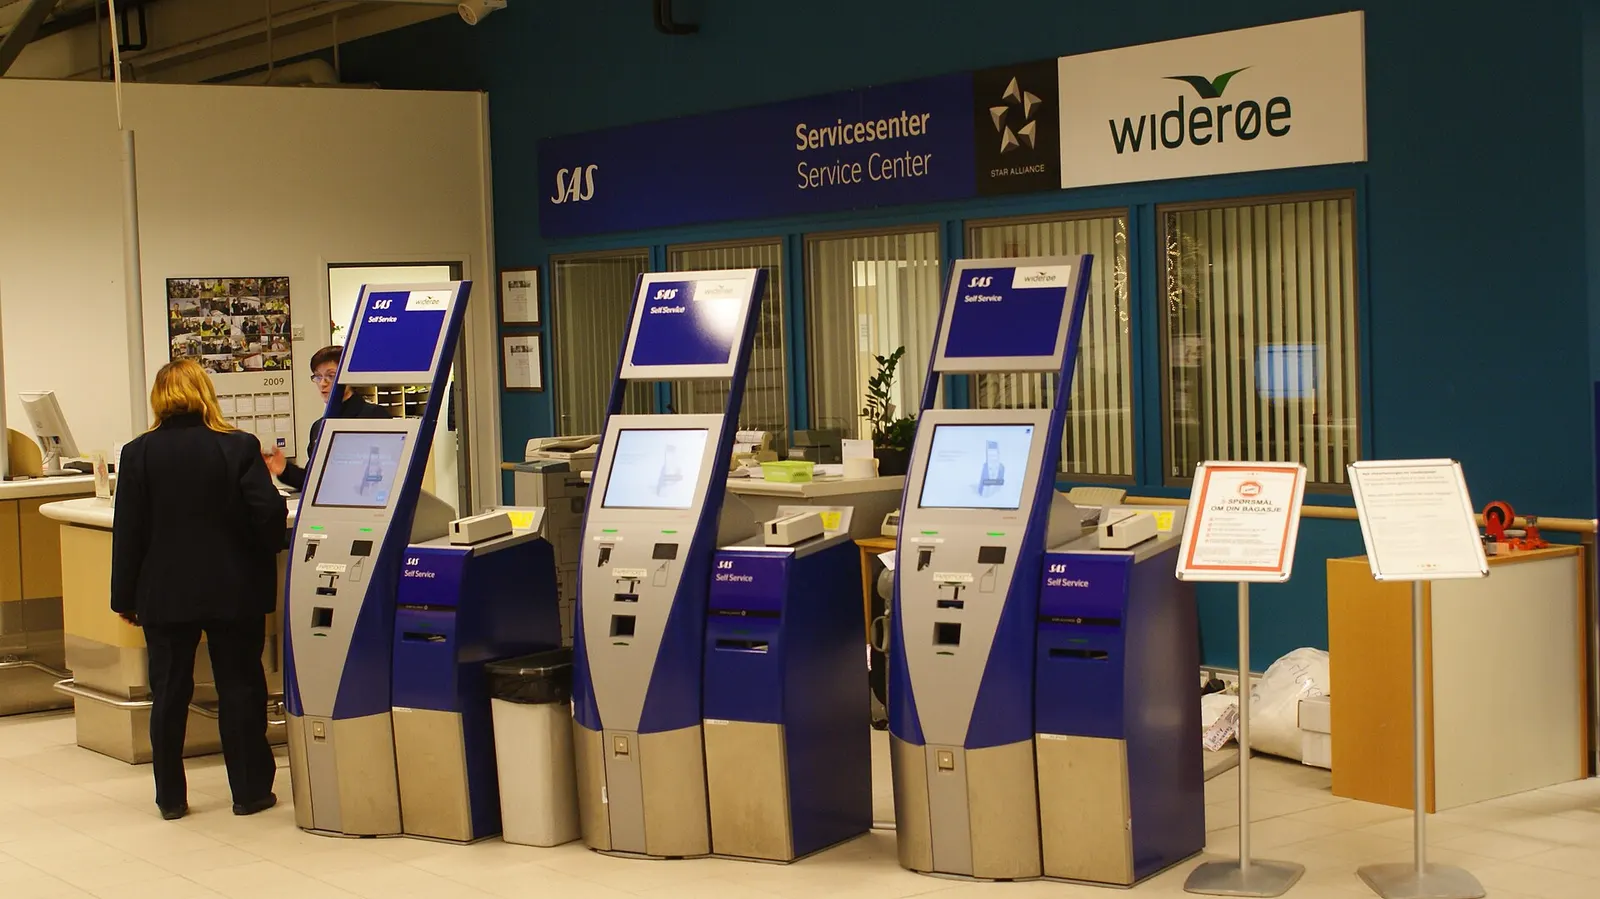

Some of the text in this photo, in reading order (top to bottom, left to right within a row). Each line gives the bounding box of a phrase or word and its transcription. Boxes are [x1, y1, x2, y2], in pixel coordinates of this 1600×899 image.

[1108, 95, 1292, 155] widerøe
[795, 109, 930, 151] Servicesenter
[797, 150, 932, 189] Service Center
[990, 164, 1045, 178] STAR ALLIANCE
[551, 164, 598, 205] SAS
[968, 276, 993, 288] SAS
[654, 288, 678, 300] SAS
[964, 294, 1003, 303] Self Service
[372, 300, 392, 309] SAS
[662, 306, 685, 314] Service
[263, 377, 285, 386] 2009
[717, 560, 733, 569] SAS
[1048, 564, 1066, 573] SAS
[415, 570, 435, 578] Service
[716, 573, 753, 582] Self Service
[1047, 577, 1089, 587] Self Service
